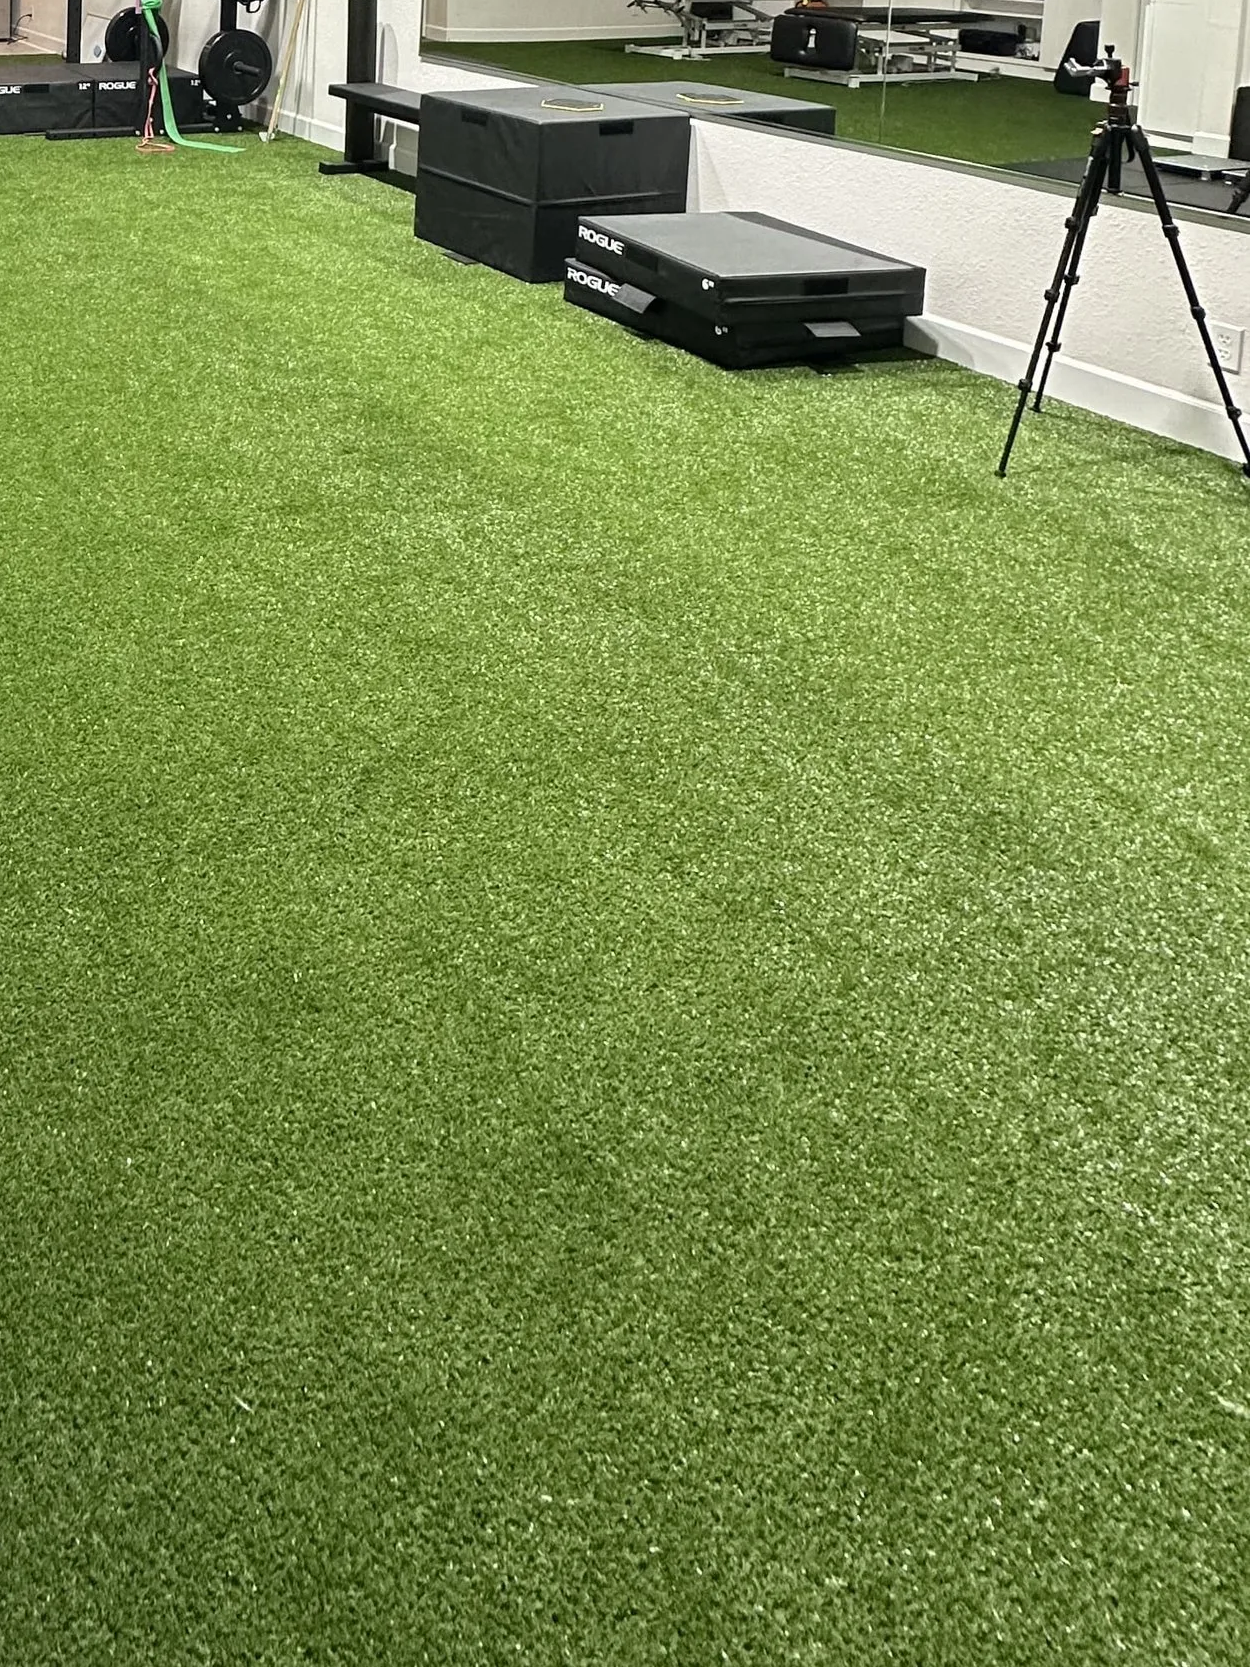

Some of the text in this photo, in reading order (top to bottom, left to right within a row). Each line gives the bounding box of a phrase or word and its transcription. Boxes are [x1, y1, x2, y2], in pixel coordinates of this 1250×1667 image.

[98, 81, 137, 90] ROGUE
[578, 225, 625, 255] ROGUE
[567, 267, 622, 297] ROGUE
